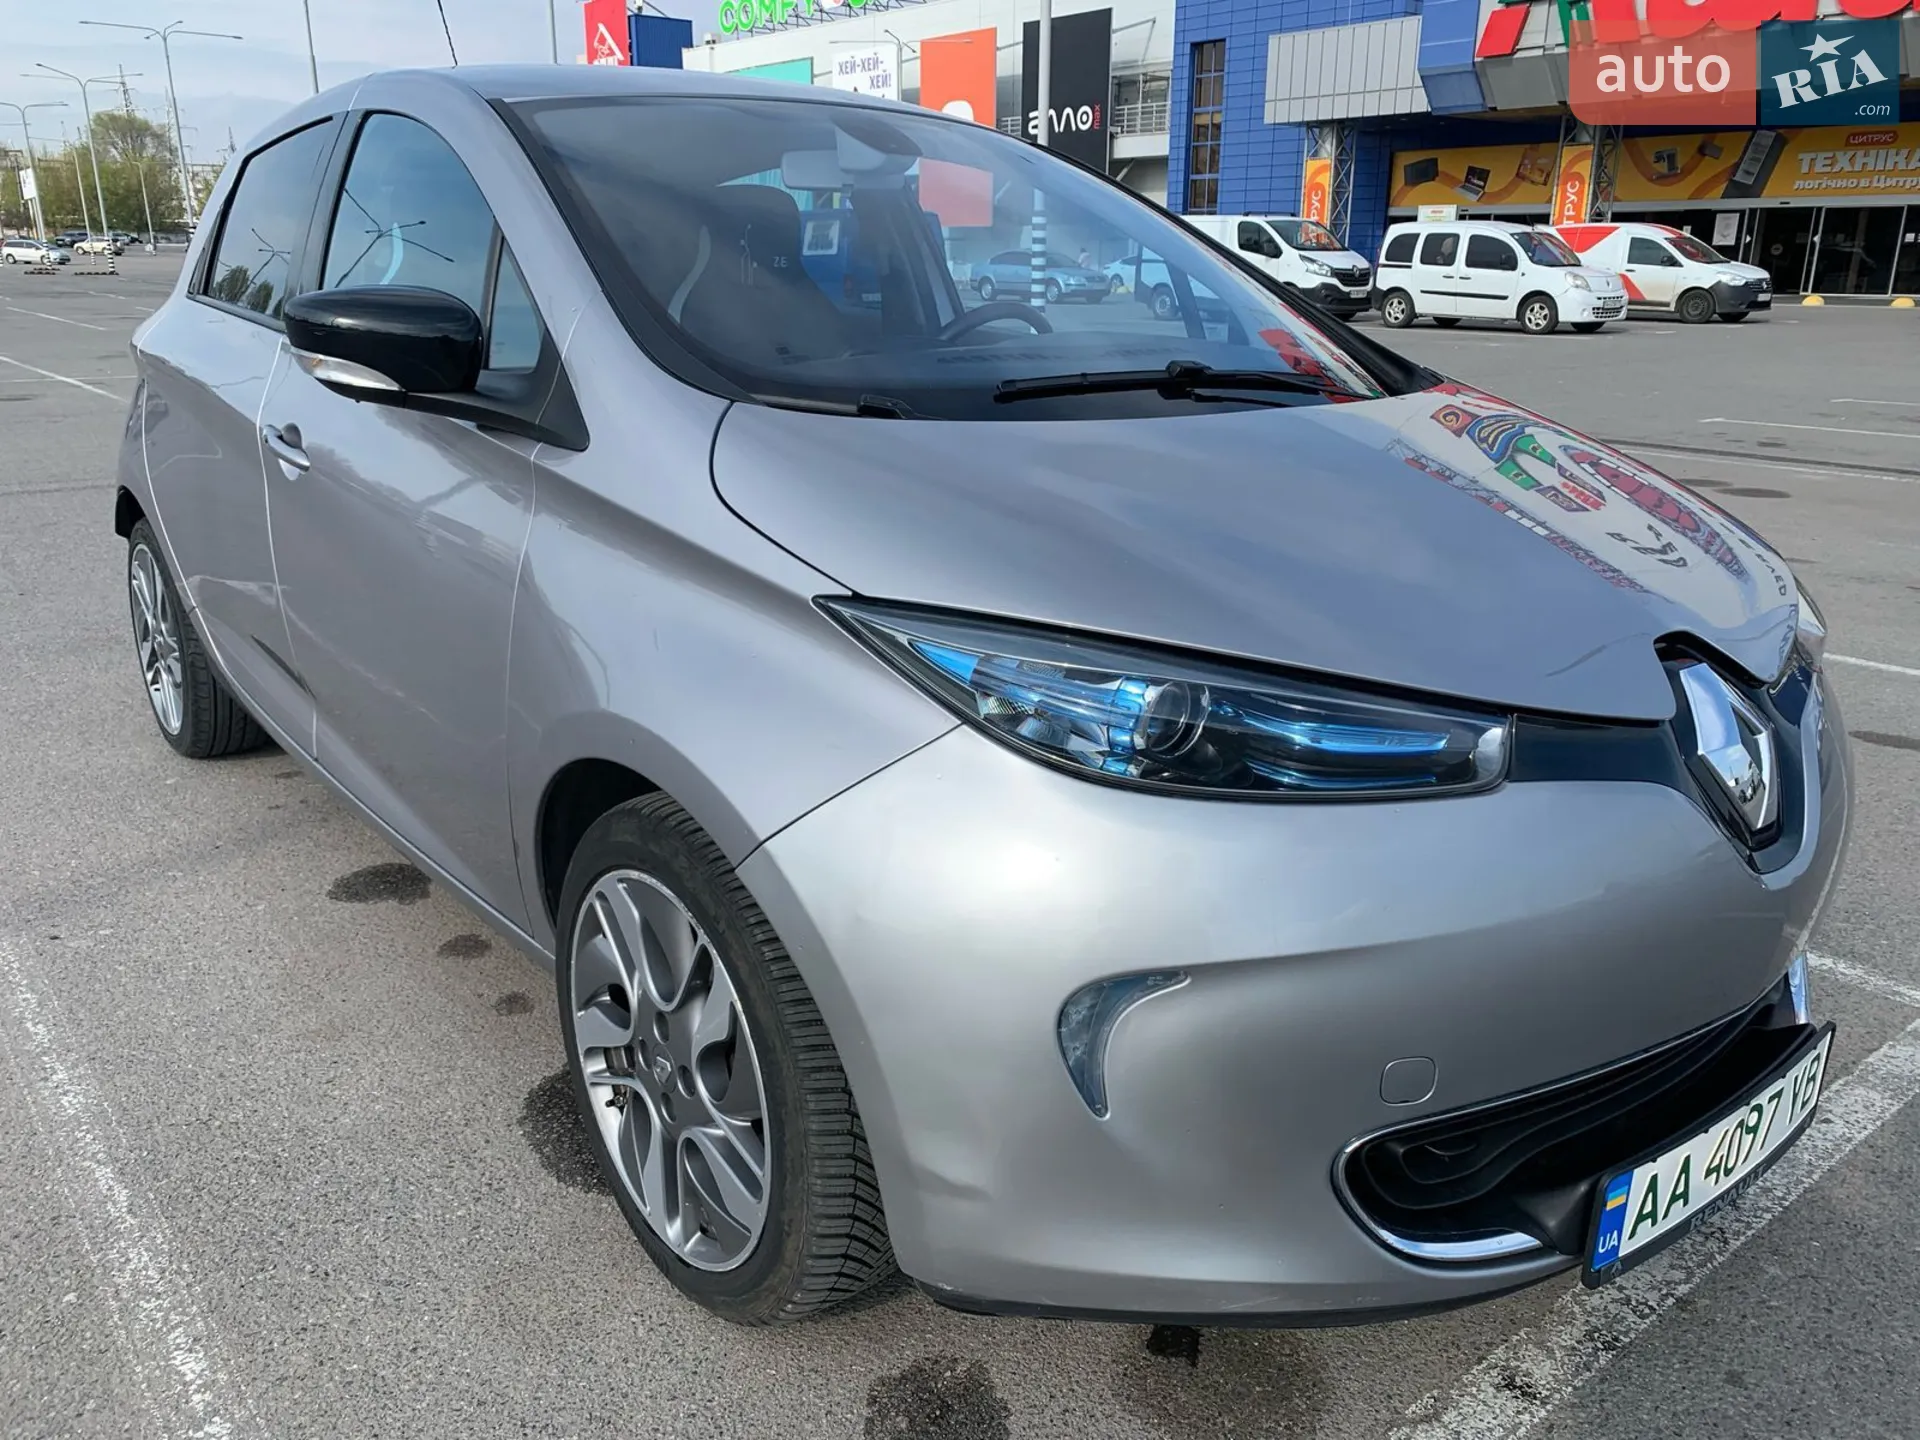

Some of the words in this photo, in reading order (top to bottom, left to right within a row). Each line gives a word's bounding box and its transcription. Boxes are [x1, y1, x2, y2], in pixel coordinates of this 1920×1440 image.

[838, 52, 884, 76] ХЕЙ-ХЕЙ-
[869, 69, 892, 90] ХЕЙ!
[1093, 103, 1101, 130] max
[1849, 132, 1895, 144] ЦИТРУС
[1794, 176, 1858, 190] логічно
[1860, 178, 1869, 187] в
[1628, 1154, 1691, 1241] AA
[1704, 1087, 1785, 1186] 4097
[1788, 1052, 1821, 1126] YB
[1690, 1164, 1767, 1230] RENAULT
[1598, 1230, 1619, 1254] UA
